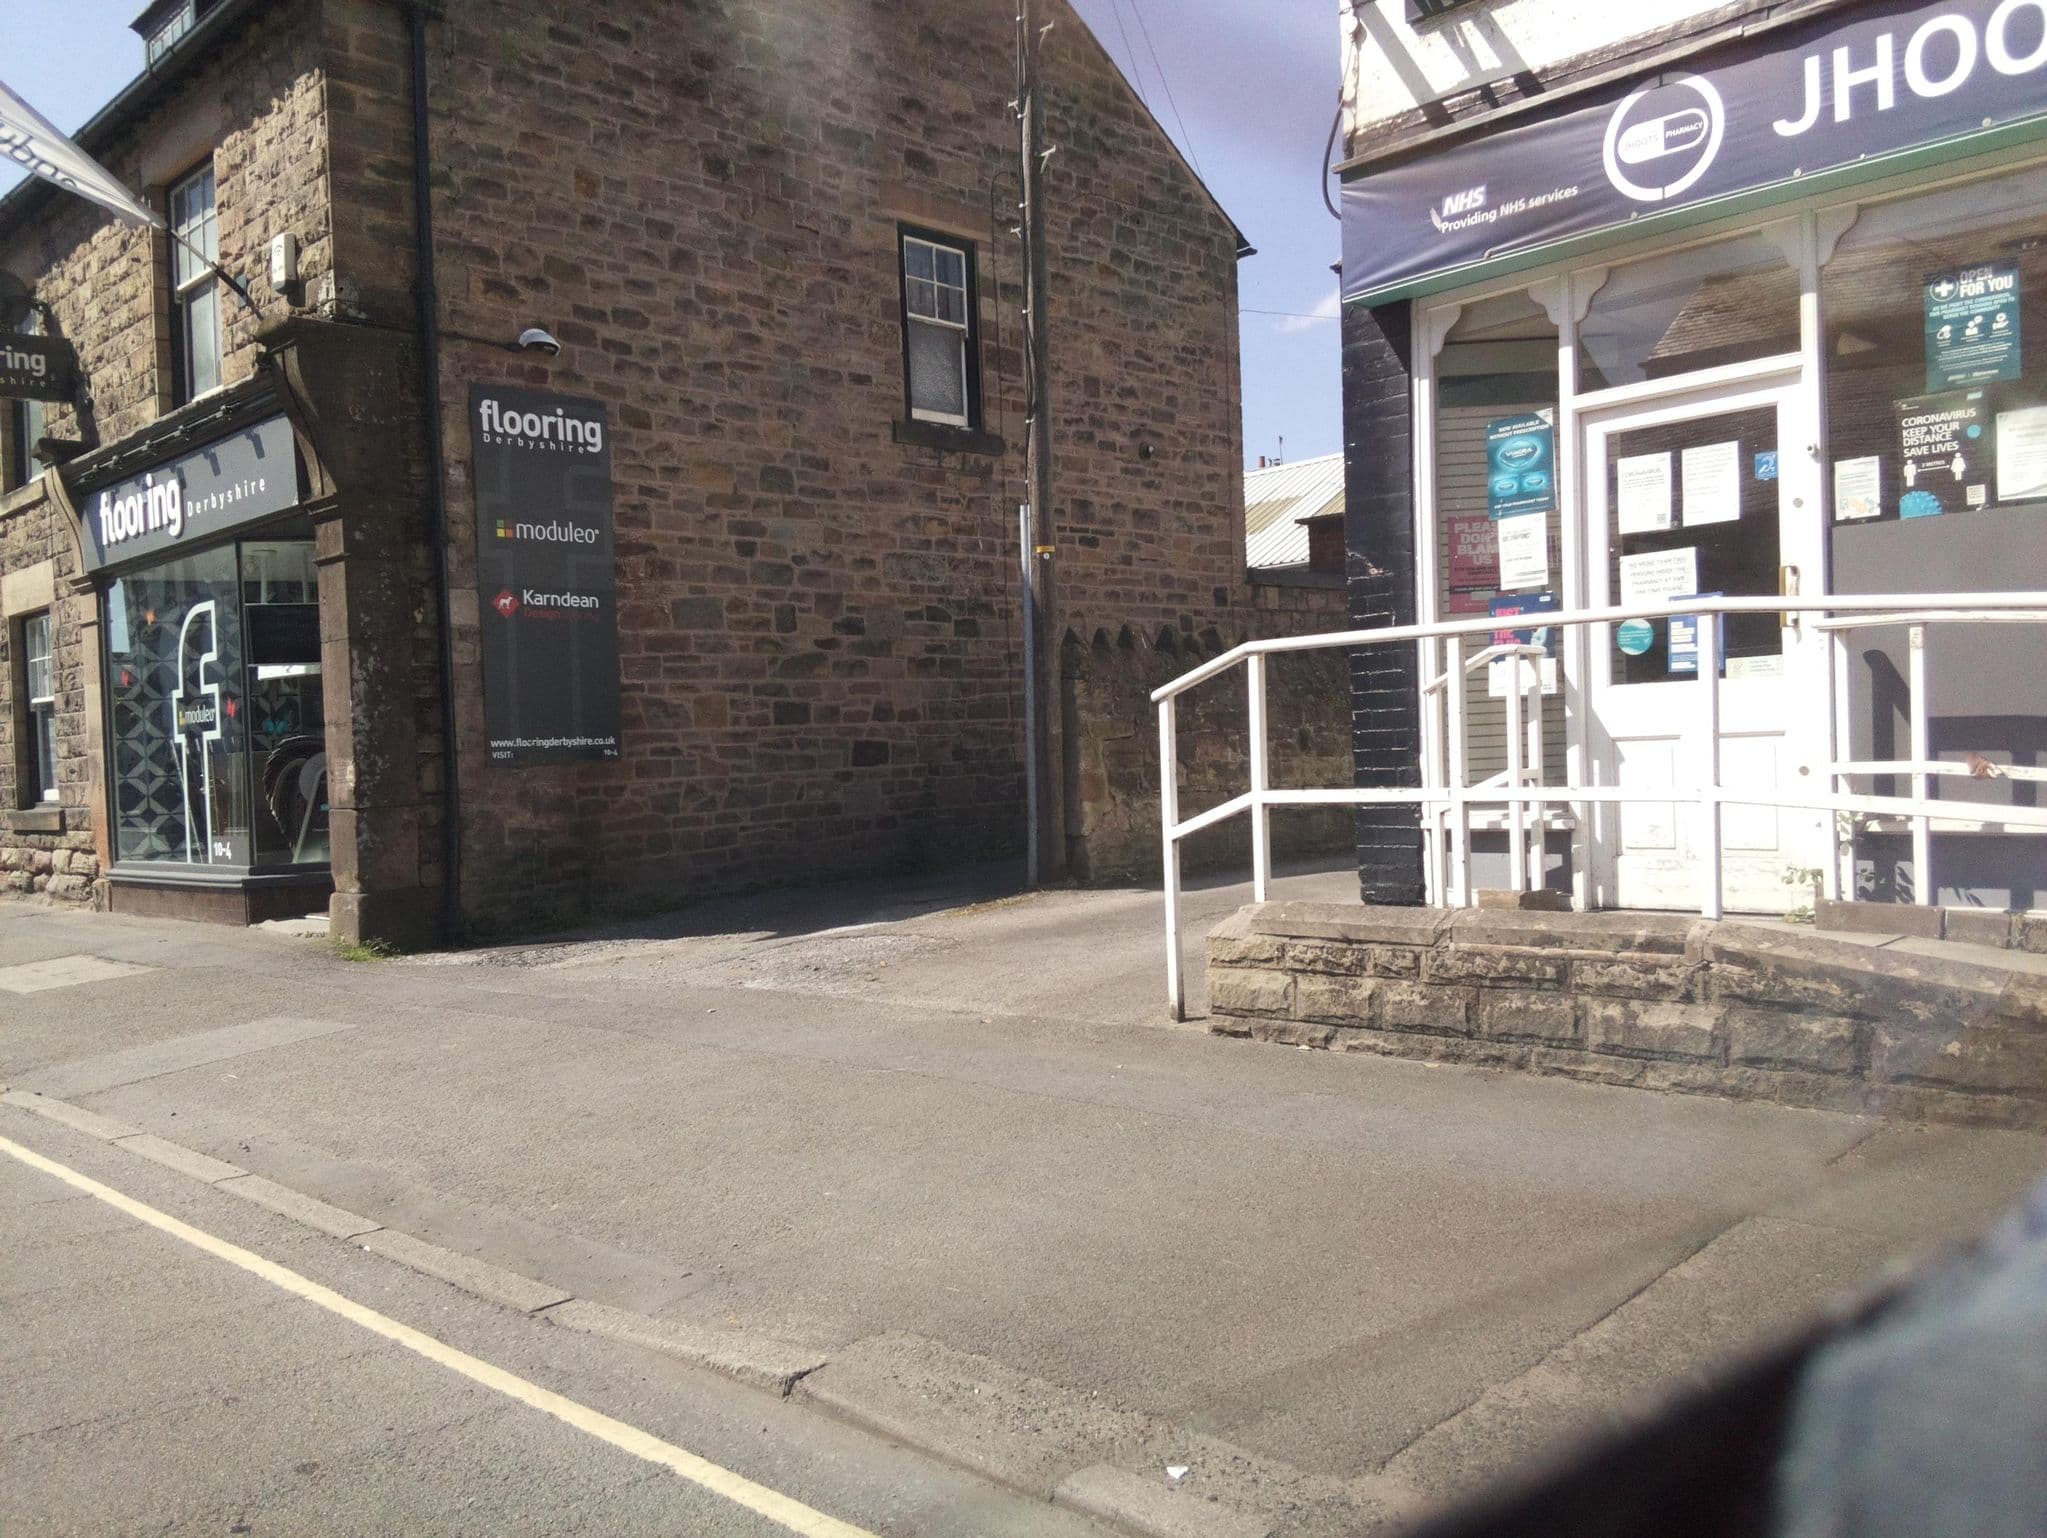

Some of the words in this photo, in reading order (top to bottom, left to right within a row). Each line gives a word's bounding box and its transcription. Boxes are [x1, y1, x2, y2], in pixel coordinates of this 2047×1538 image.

[1665, 121, 1703, 138] PHARMACY
[1441, 209, 1497, 233] Providing
[1500, 198, 1526, 217] NHS
[1529, 185, 1579, 209] services
[1442, 184, 1486, 217] NHS
[1960, 266, 1993, 284] OPEN
[1960, 282, 1984, 298] FOR
[1987, 275, 2013, 293] YOU
[0, 345, 46, 377] ing
[480, 399, 602, 453] flooring
[1902, 408, 1976, 427] CORONAVIRUS
[1903, 426, 1928, 438] KEEP
[1930, 421, 1960, 434] YOUR
[483, 433, 584, 454] Derbyshire
[1903, 432, 1952, 447] DISTANCE
[1904, 445, 1929, 457] SAVE
[1931, 441, 1959, 453] LIVES
[1505, 447, 1533, 457] VIAGRA
[187, 478, 266, 517] Derbyshire
[100, 473, 181, 546] flooring
[523, 589, 599, 608] Karndean
[490, 736, 616, 749] www.flooringderbyshire.co.uk
